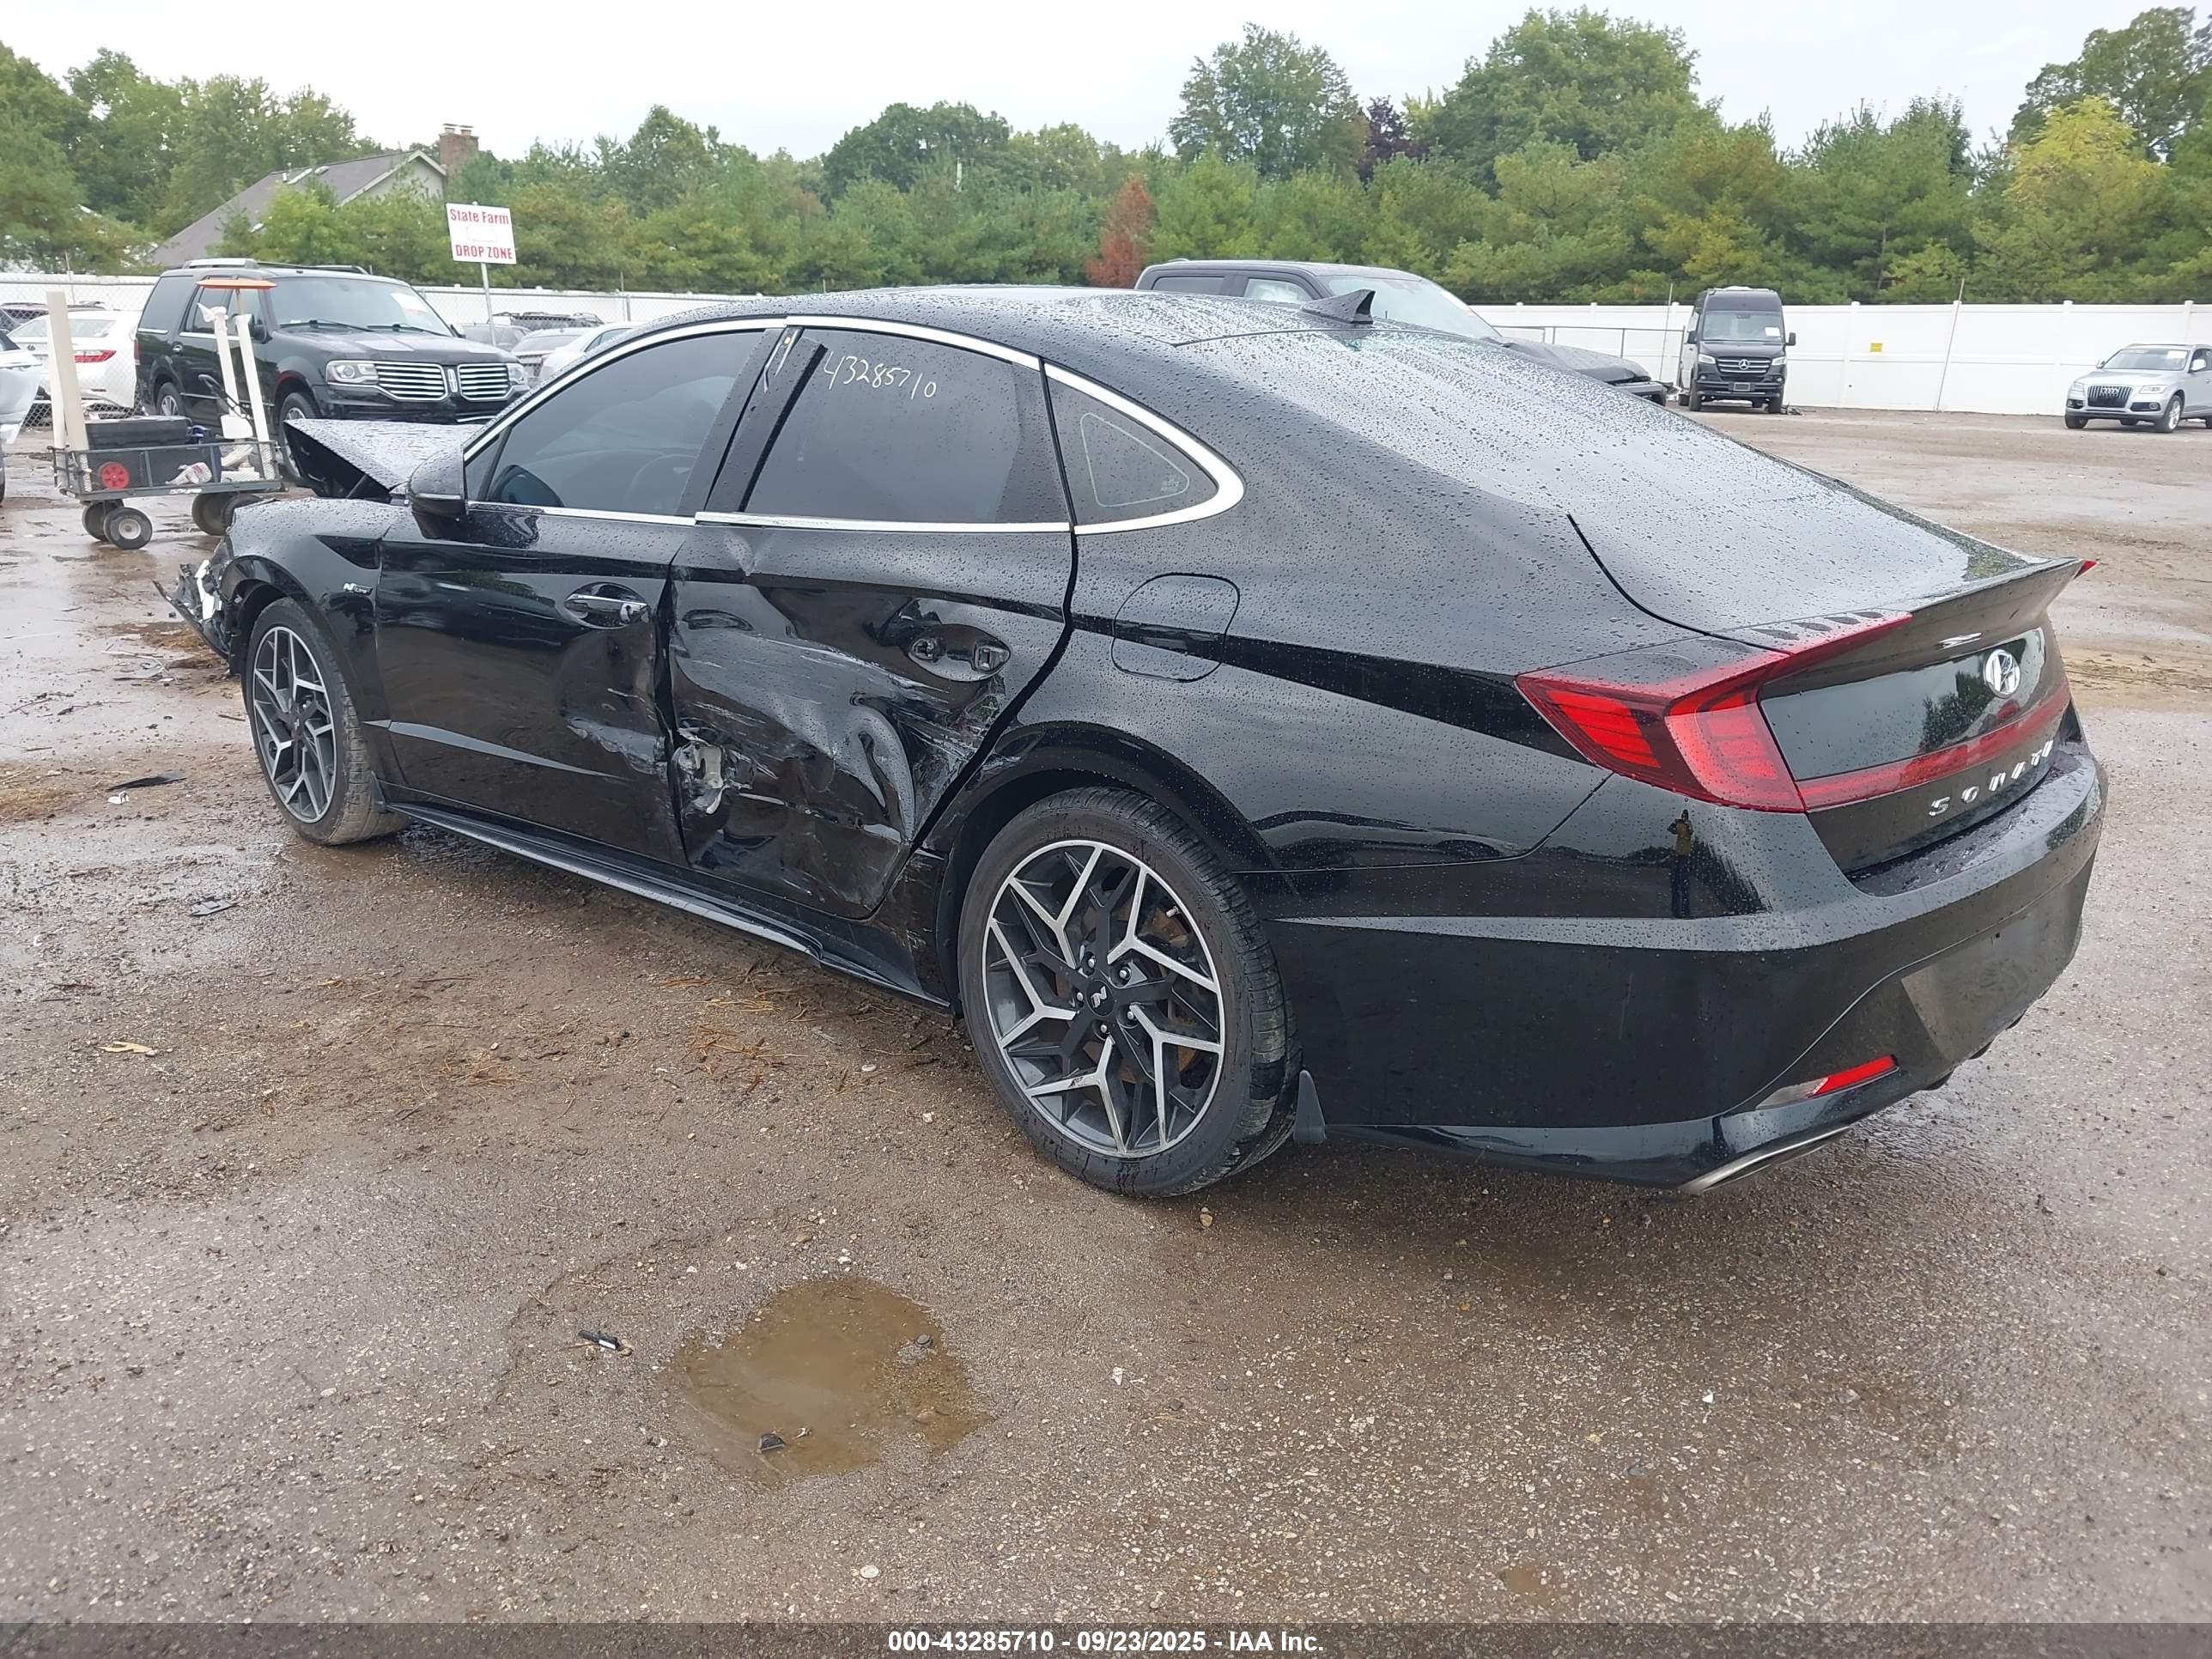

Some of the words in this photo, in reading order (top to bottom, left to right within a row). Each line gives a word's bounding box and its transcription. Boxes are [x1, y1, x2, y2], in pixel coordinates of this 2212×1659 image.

[449, 209, 479, 222] State
[482, 211, 509, 225] Farm
[455, 244, 484, 258] DROP
[486, 246, 514, 259] ZONE
[823, 351, 937, 399] 43285710
